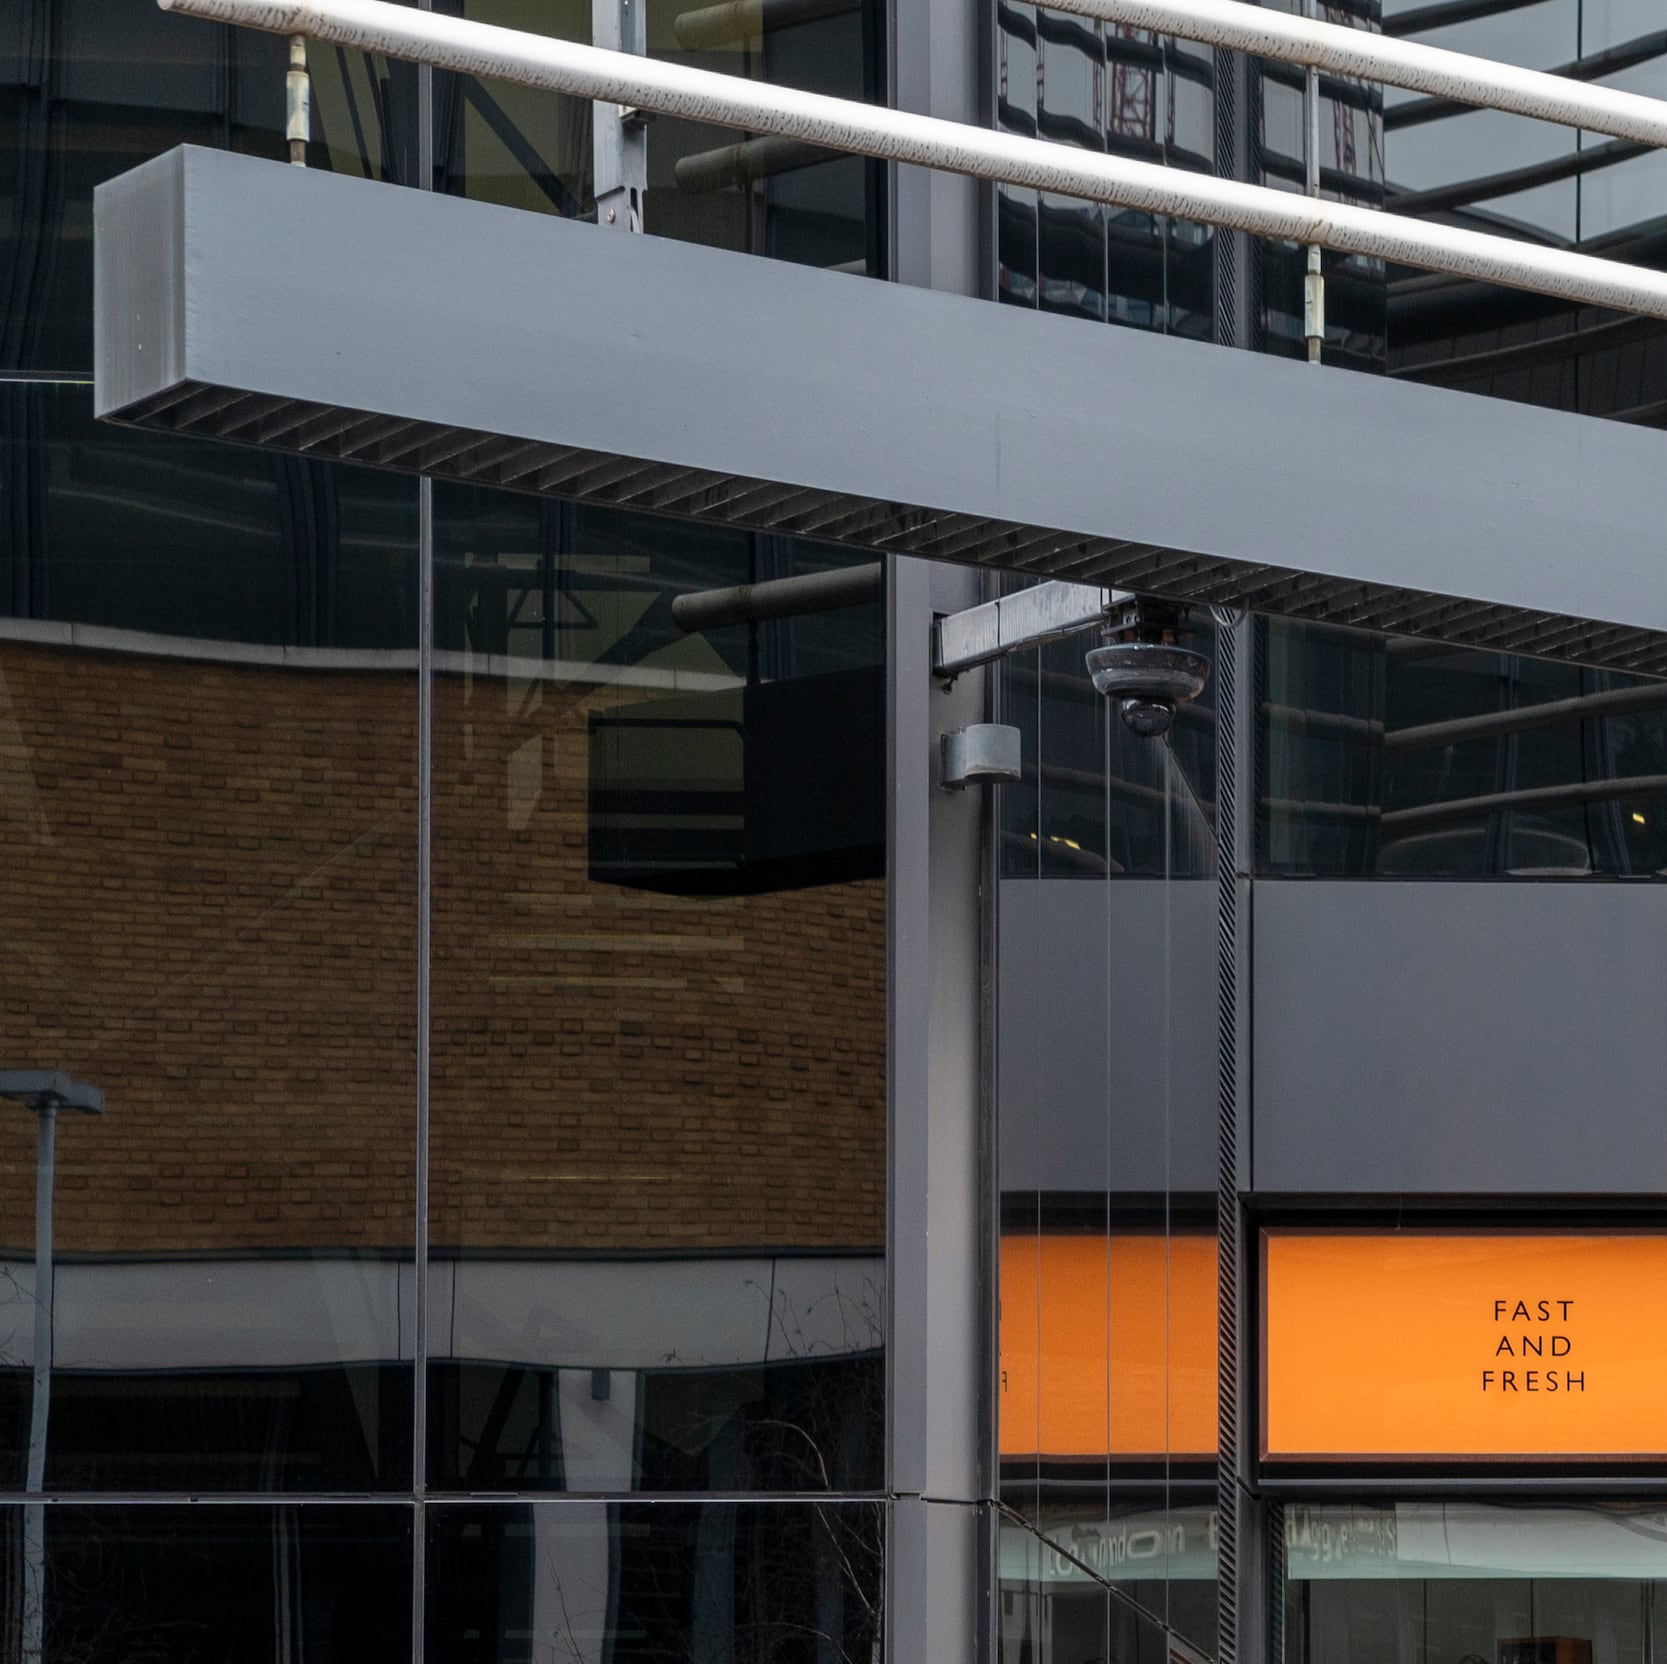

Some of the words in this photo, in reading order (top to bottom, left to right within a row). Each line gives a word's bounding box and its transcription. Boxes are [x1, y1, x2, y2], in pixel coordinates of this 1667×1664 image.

[1494, 1300, 1576, 1322] FAST
[1495, 1336, 1573, 1358] AND
[1482, 1370, 1587, 1393] FRESH
